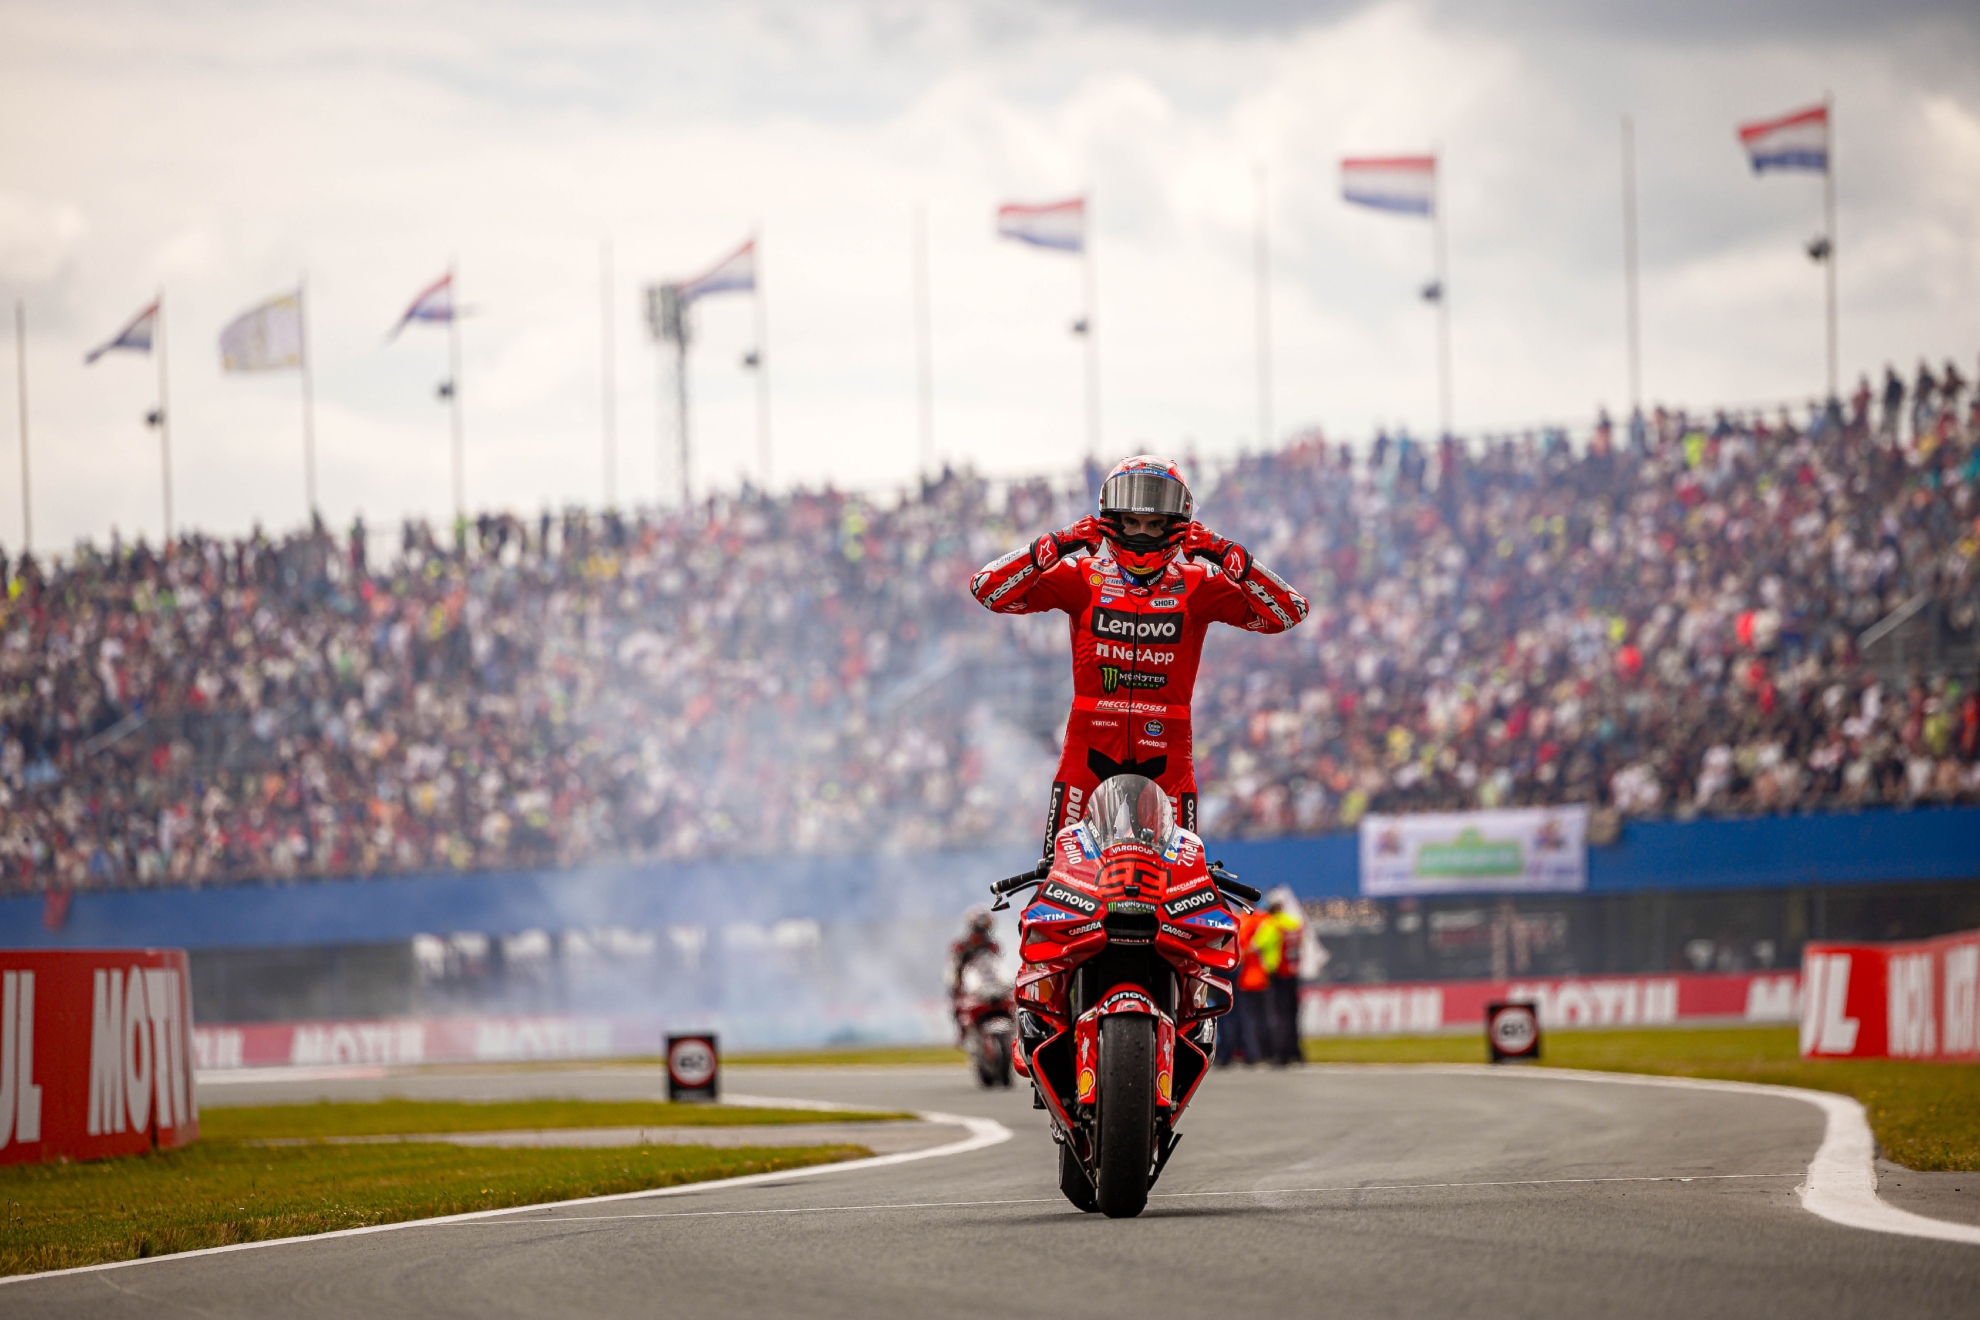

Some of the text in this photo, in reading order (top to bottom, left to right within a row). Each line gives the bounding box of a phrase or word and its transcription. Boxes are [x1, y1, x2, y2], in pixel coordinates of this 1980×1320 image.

[982, 563, 1034, 610] inestars
[1124, 573, 1135, 583] TIM
[1146, 570, 1164, 586] Lenovo
[1097, 613, 1176, 637] Lenovo
[1112, 645, 1174, 665] NetApp
[1119, 672, 1165, 683] MONSTER
[1096, 700, 1167, 713] FRECCIAROSSA
[1064, 785, 1083, 828] DUC
[1045, 787, 1061, 853] Lenovo
[1165, 875, 1210, 894] FRECCIAROSSA
[1045, 883, 1096, 912] Lenovo
[1117, 900, 1156, 911] MONSTER
[1164, 891, 1215, 915] Lenovo
[1044, 912, 1066, 921] TIM
[1068, 921, 1102, 936] CARRERA
[1102, 991, 1155, 1010] Lenovo
